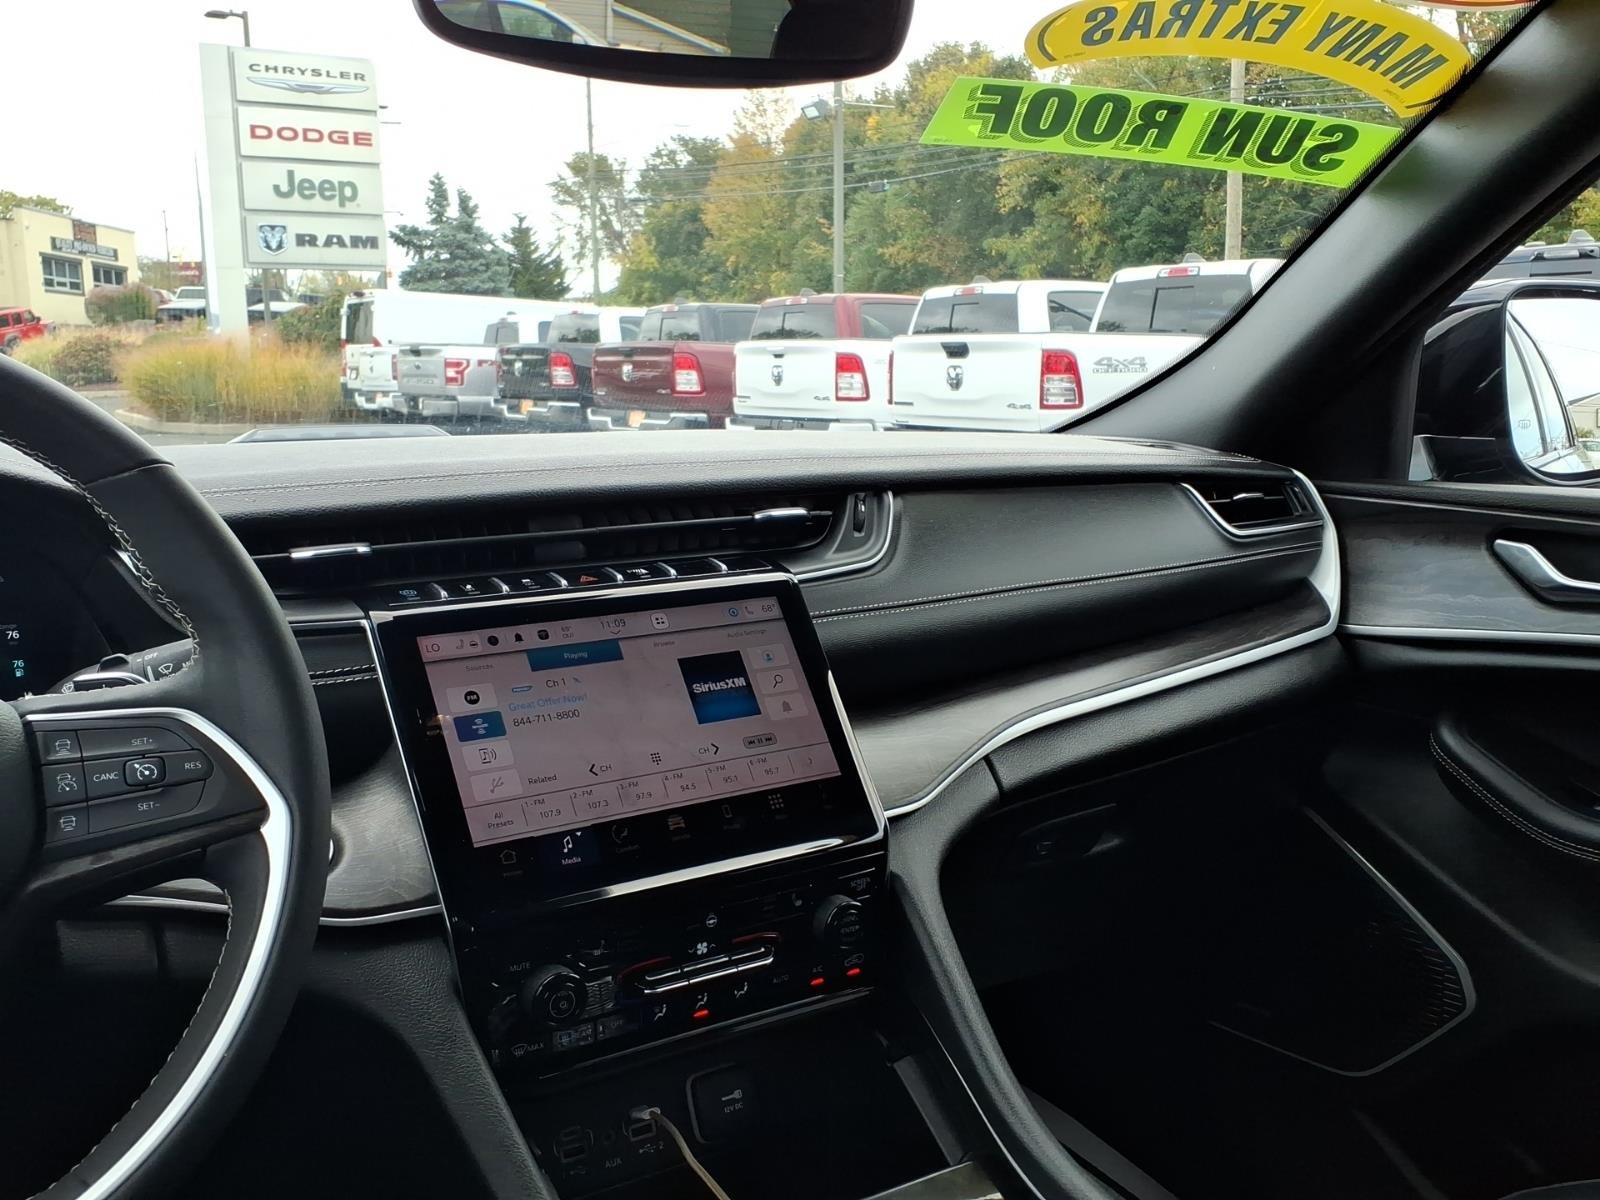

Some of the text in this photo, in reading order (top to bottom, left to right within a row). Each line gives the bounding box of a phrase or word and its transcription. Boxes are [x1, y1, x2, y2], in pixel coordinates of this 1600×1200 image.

[249, 63, 367, 82] CHRYSLER
[249, 124, 373, 147] DODGE
[273, 170, 359, 207] Jeep
[295, 232, 379, 250] RAM
[600, 618, 627, 630] 11:09
[5, 630, 20, 640] 76
[425, 643, 440, 654] LO
[563, 650, 589, 661] Playing
[12, 660, 25, 668] 76
[545, 678, 560, 689] Ch
[692, 677, 747, 695] SiriusXM
[508, 701, 535, 712] Great
[536, 697, 562, 708] Offer
[512, 709, 581, 728] 844-711-8800
[184, 761, 202, 771] RES
[93, 771, 119, 782] CANC
[527, 774, 558, 786] Related
[538, 808, 562, 820] 107.9
[487, 819, 515, 830] Presets
[561, 856, 582, 866] Media
[510, 962, 531, 972] MUTE
[604, 1157, 623, 1168] AUX
